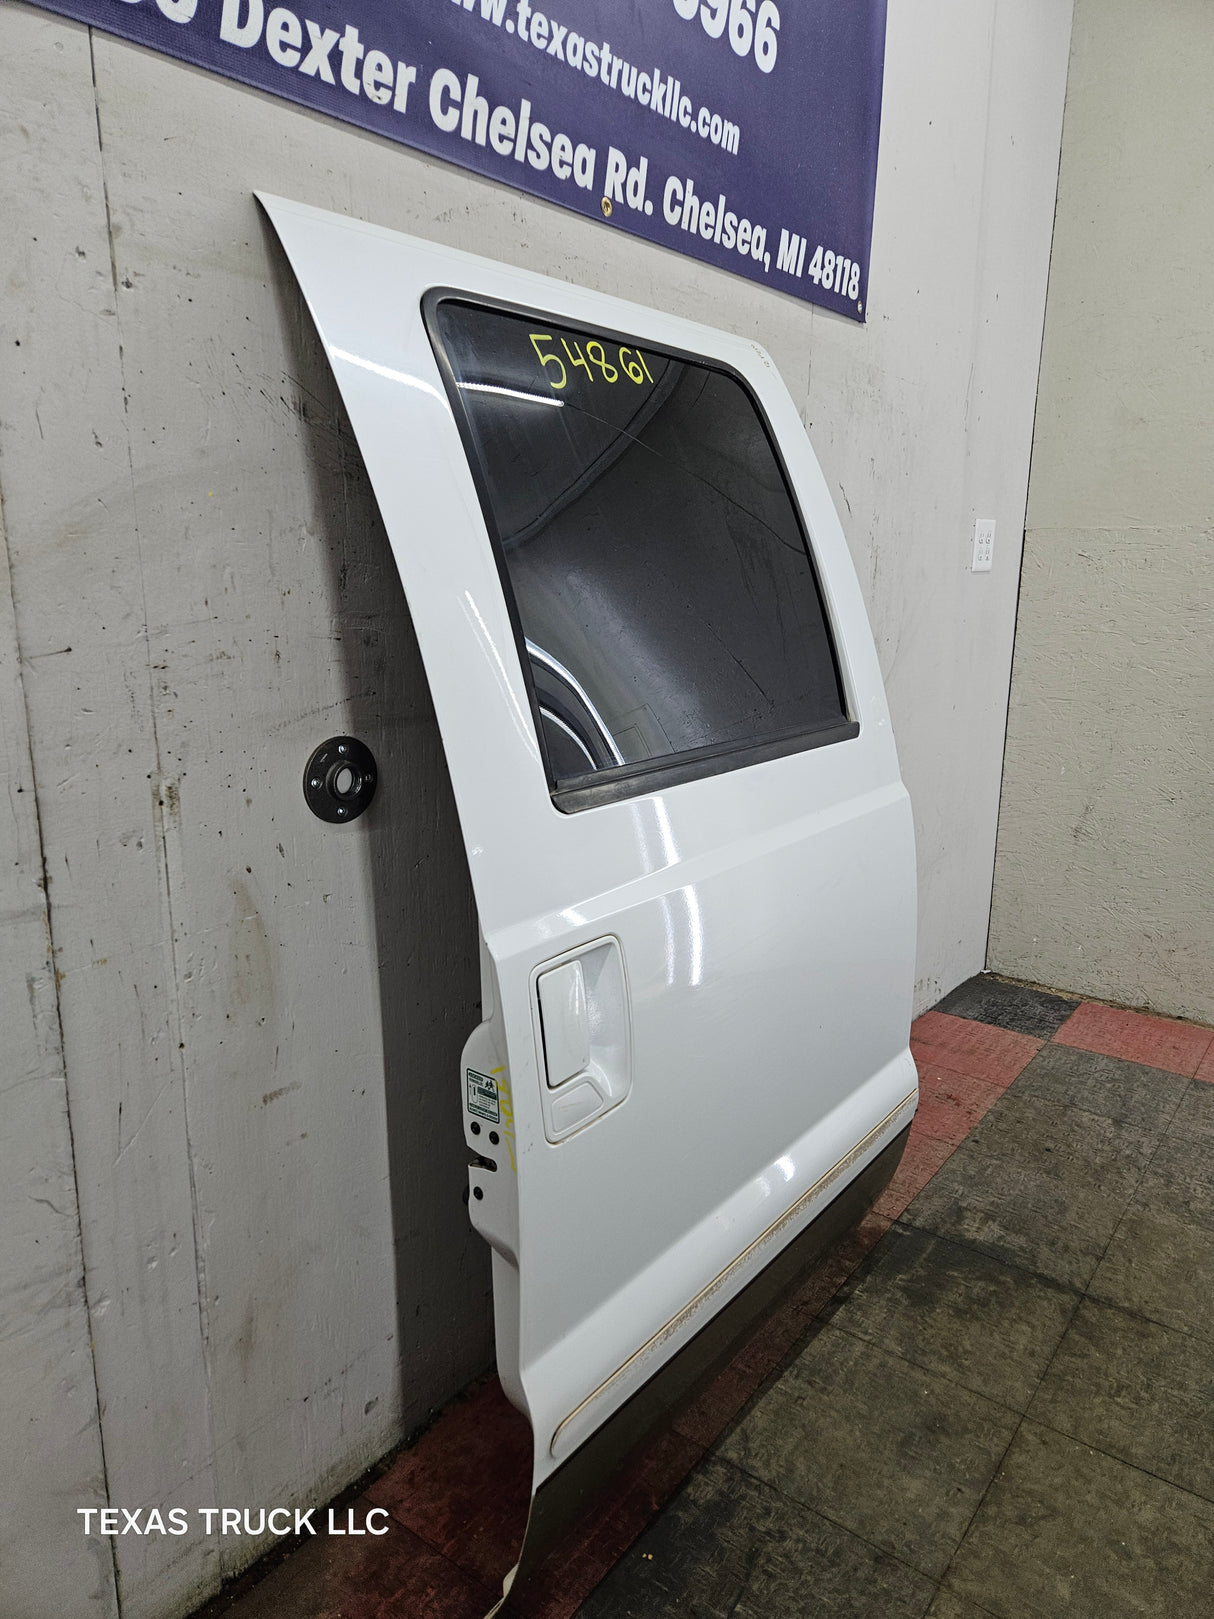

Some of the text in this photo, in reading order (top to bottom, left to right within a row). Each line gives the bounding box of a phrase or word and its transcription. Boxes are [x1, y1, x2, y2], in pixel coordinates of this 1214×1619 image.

[672, 0, 781, 74] 966
[219, 0, 861, 300] Dexter Chelsea Rd. Chelsea, MI 48118
[529, 333, 654, 390] 54861
